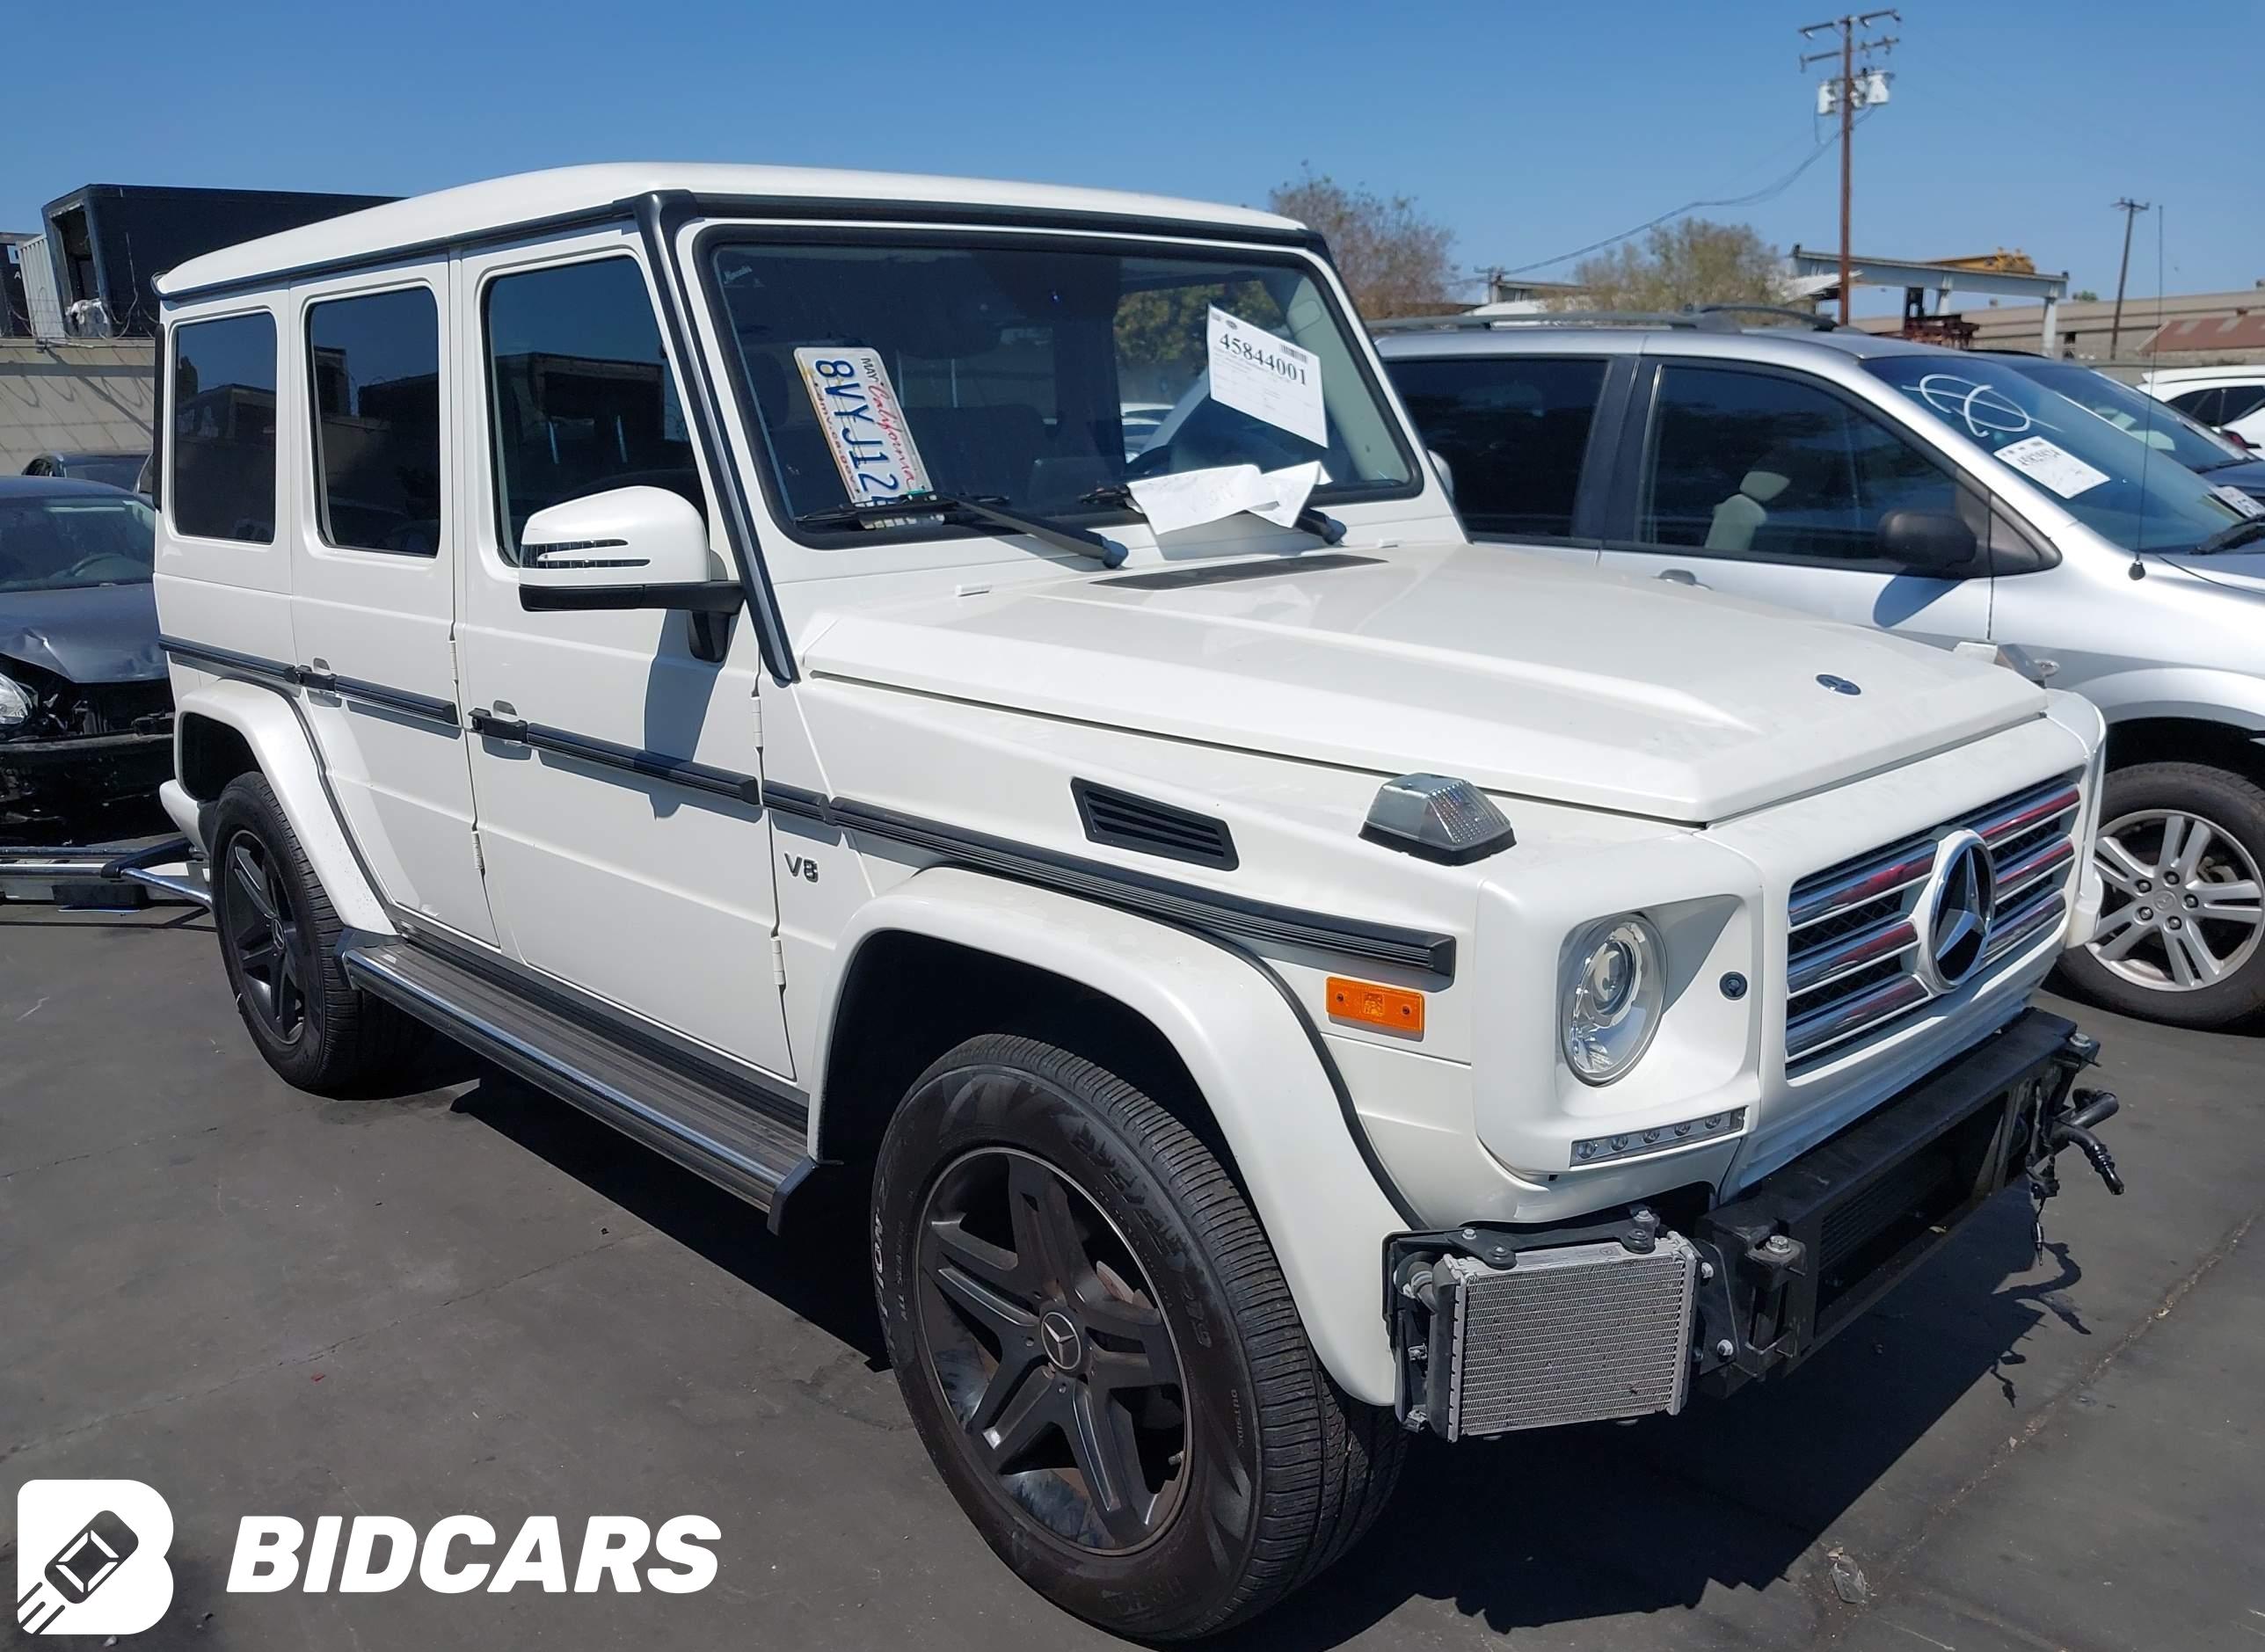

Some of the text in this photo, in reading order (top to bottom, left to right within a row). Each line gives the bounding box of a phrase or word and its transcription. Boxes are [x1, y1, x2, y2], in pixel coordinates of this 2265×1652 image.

[860, 357, 879, 382] MAY
[1220, 333, 1307, 386] 45844001
[867, 384, 915, 491] California
[784, 852, 819, 883] V8
